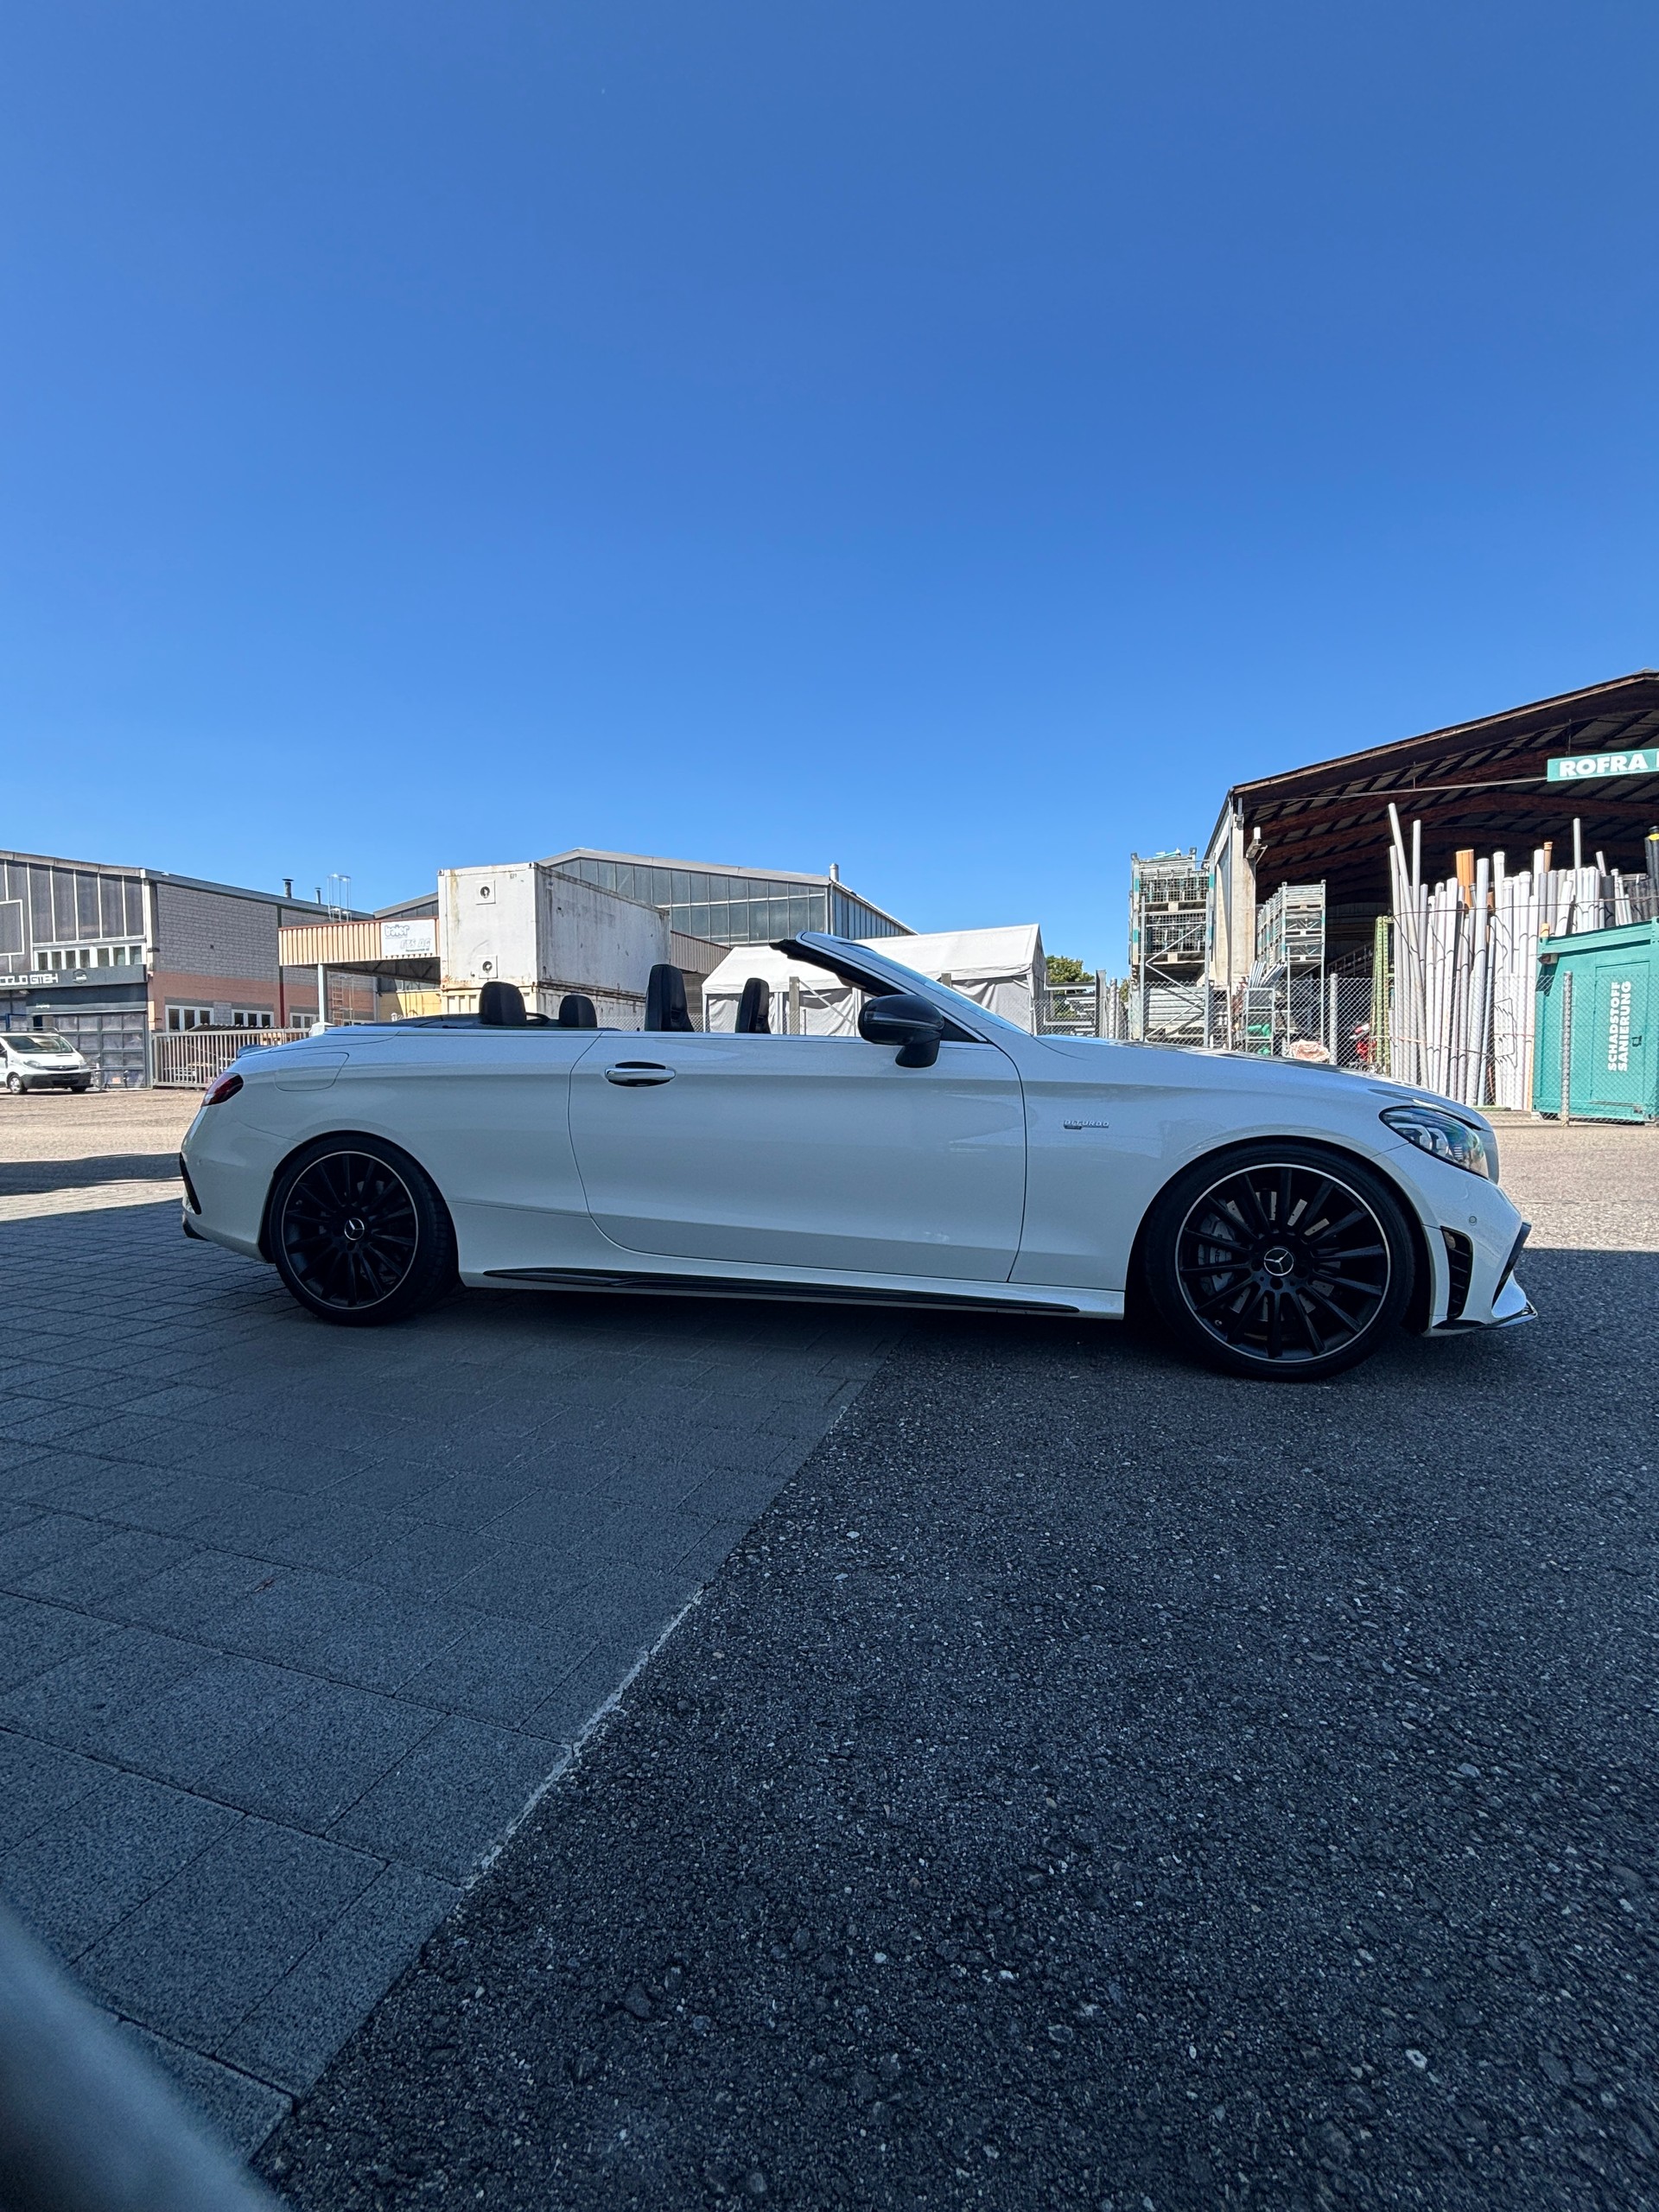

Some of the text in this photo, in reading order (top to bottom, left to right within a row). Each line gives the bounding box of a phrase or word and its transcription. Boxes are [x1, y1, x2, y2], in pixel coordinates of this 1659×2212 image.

[1560, 753, 1648, 777] ROFRA
[1608, 982, 1620, 1071] SCHADSTOFF
[1618, 981, 1631, 1071] SANIERUNG
